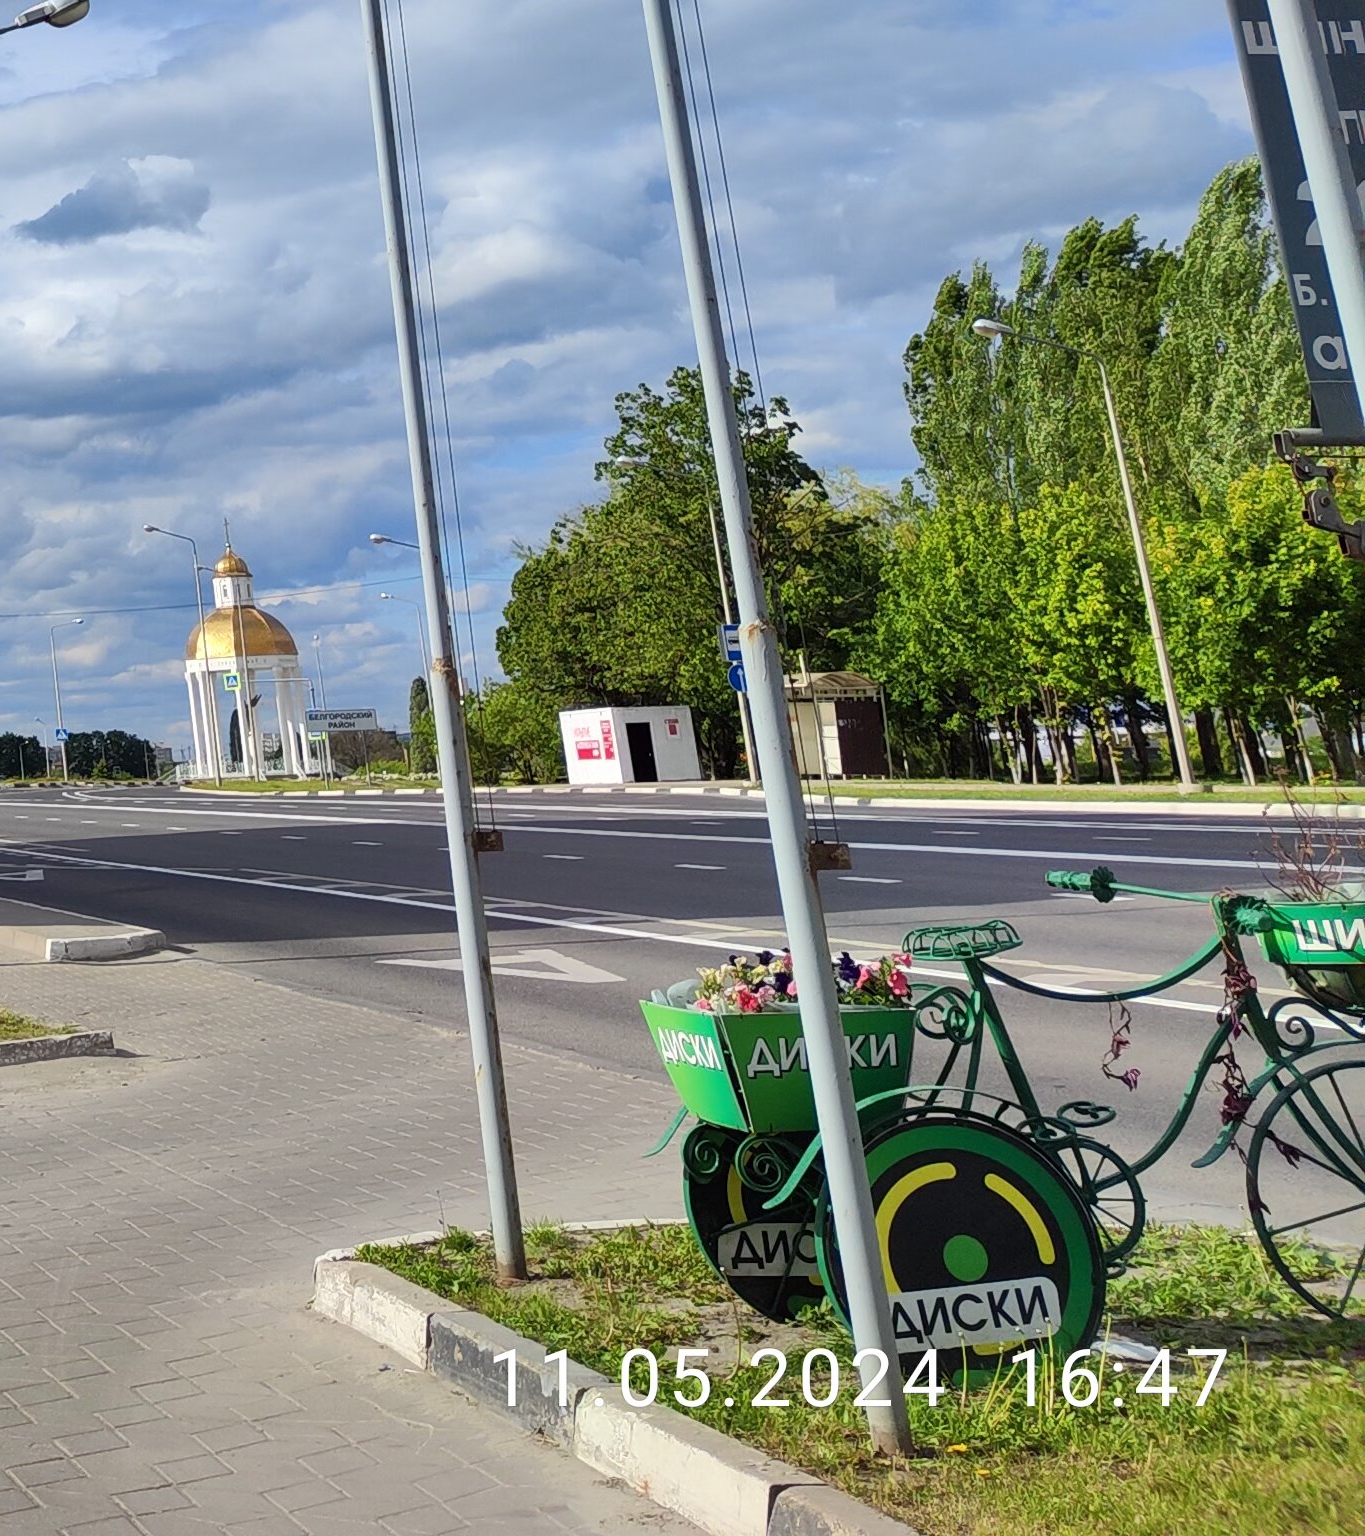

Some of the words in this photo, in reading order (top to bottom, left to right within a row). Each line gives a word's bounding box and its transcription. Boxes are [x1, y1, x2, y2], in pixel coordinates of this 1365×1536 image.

[308, 710, 373, 720] БЕЛГОРОДСКИЙ
[327, 720, 356, 729] РАЙОН
[657, 1026, 722, 1071] ДИСКИ
[747, 1033, 898, 1079] ДИКИ
[731, 1229, 817, 1270] ДИС
[892, 1284, 1050, 1345] ДИСКИ
